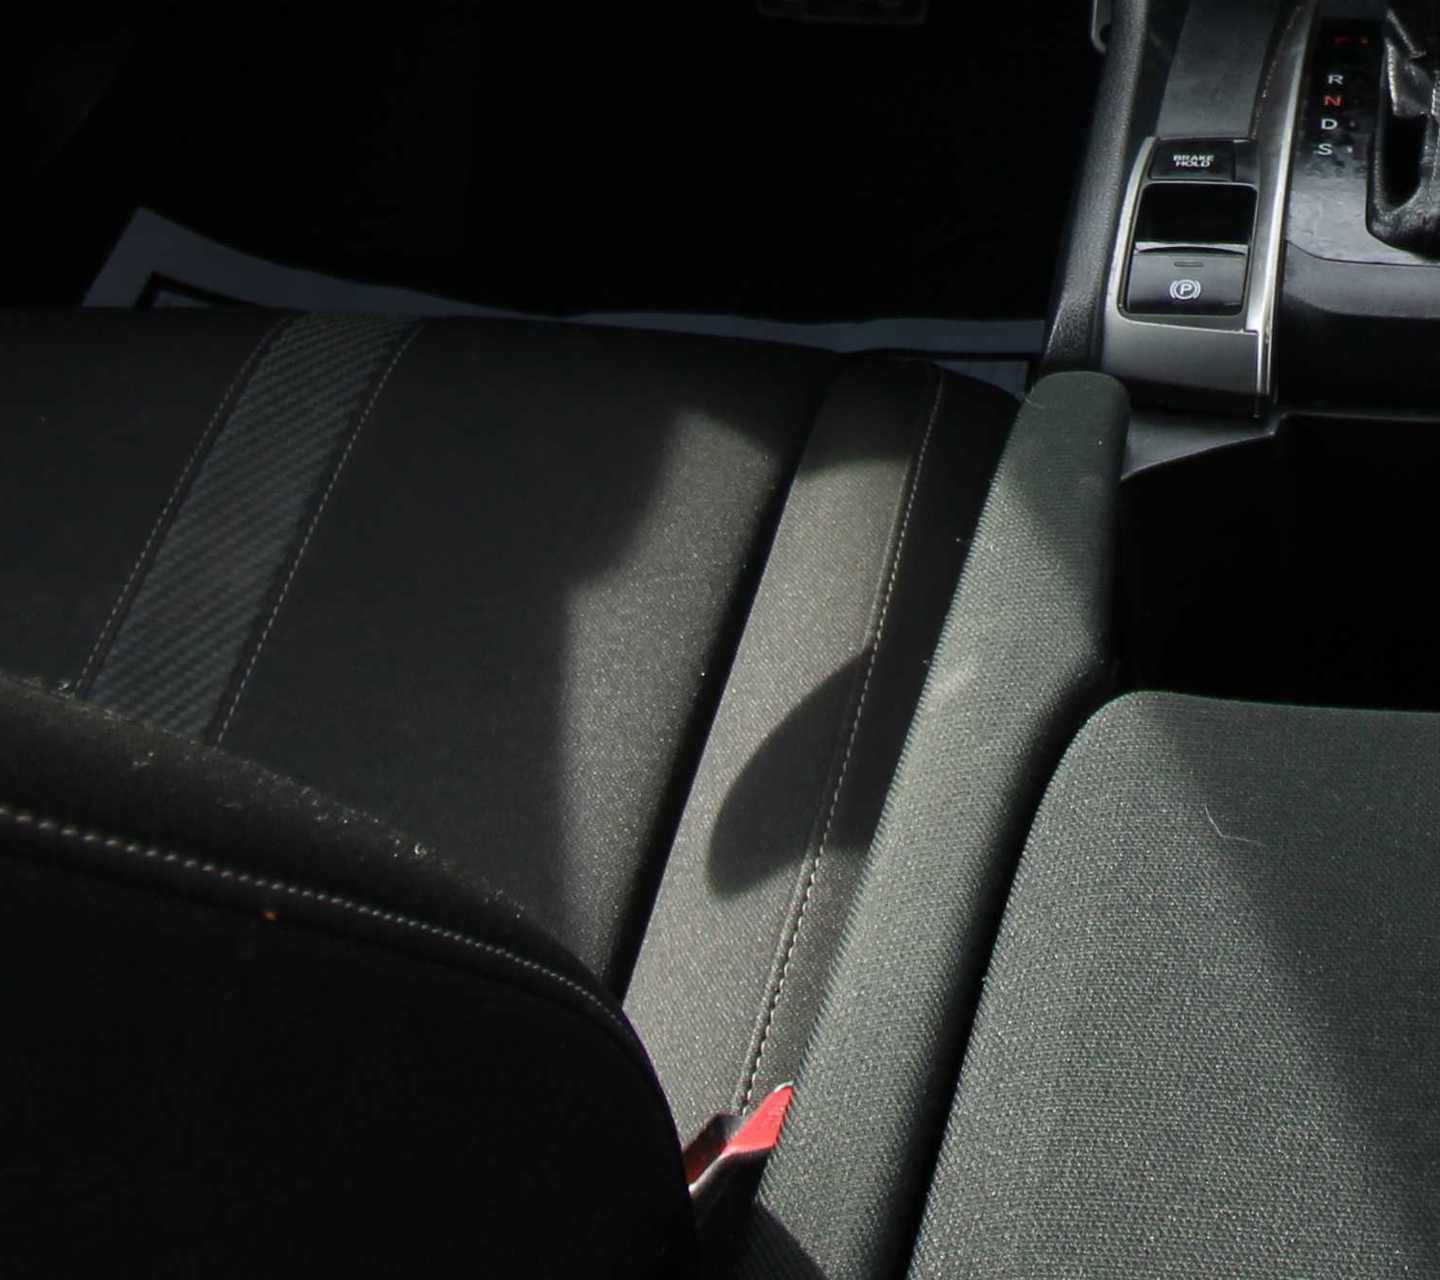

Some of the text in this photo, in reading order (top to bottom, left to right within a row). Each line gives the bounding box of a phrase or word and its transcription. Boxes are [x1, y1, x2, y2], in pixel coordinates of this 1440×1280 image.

[1328, 73, 1345, 86] R
[1323, 95, 1342, 108] N
[1321, 118, 1338, 130] D
[1318, 143, 1334, 156] S
[1175, 160, 1211, 168] HOLD
